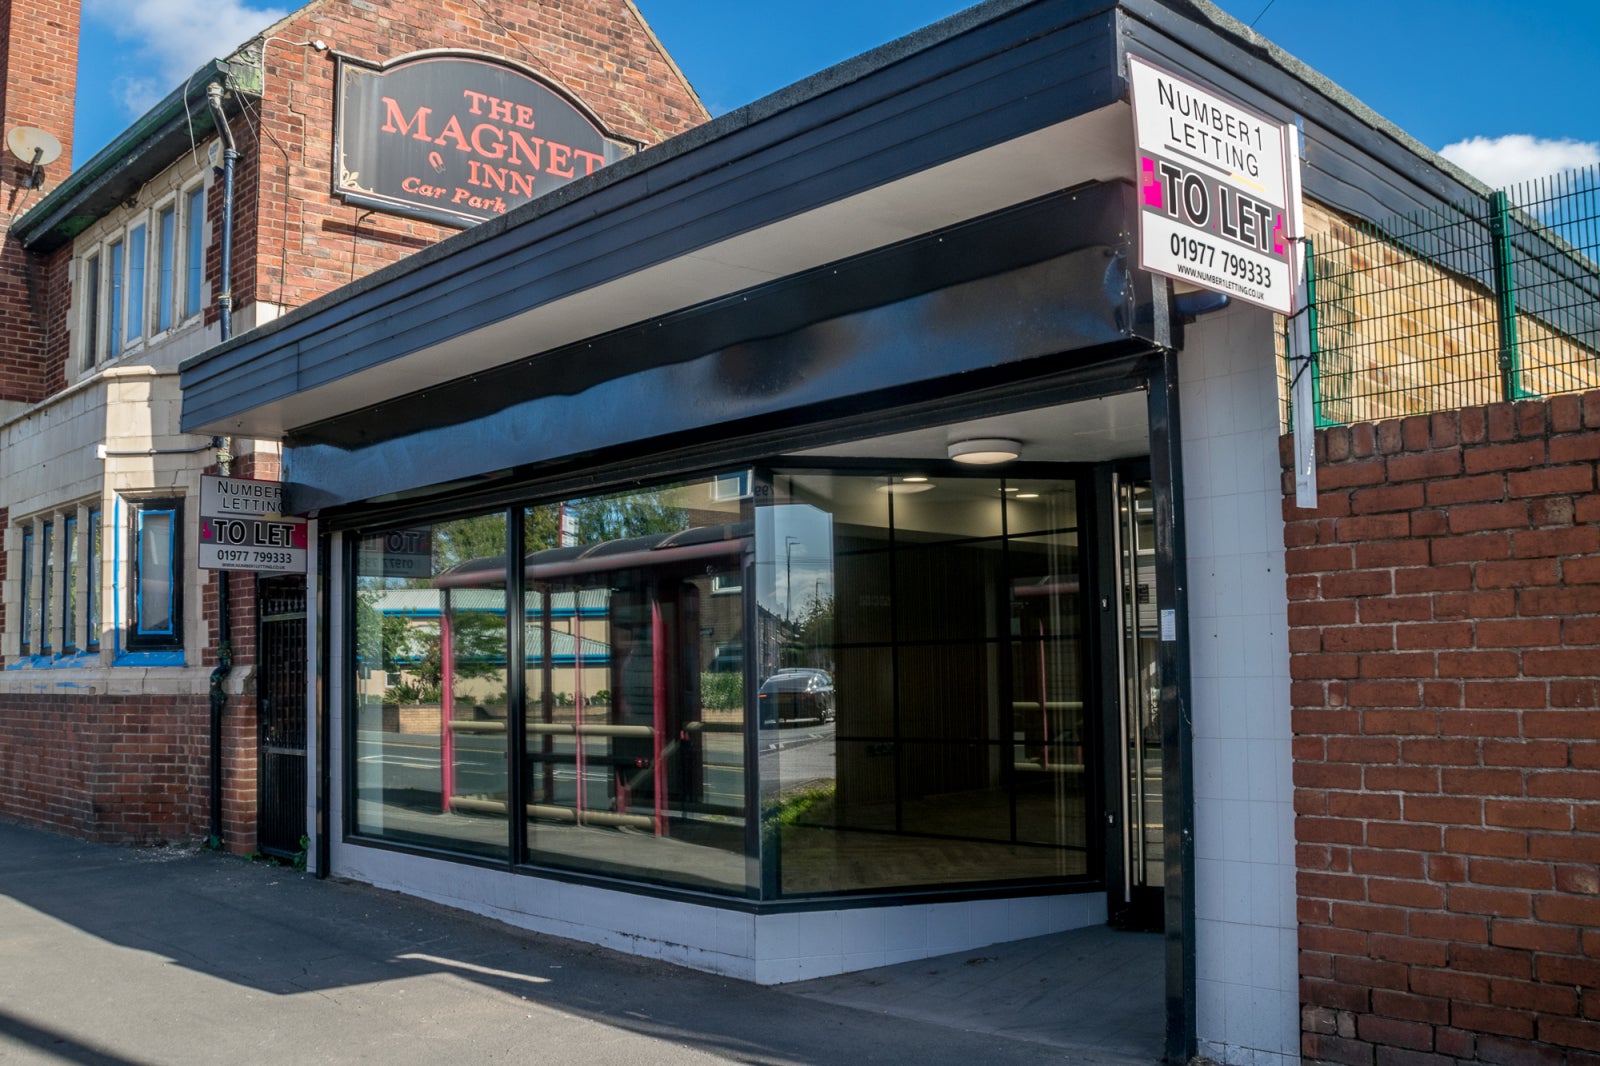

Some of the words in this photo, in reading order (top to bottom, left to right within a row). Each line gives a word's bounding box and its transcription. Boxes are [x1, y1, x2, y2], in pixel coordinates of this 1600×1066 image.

[464, 90, 535, 130] THE
[381, 97, 605, 180] MAGNET
[1169, 116, 1259, 178] LETTING
[402, 176, 447, 200] Car
[451, 187, 507, 214] Park
[467, 160, 535, 199] INN
[1160, 160, 1209, 227] TO
[1218, 185, 1273, 253] LET
[1170, 233, 1215, 268] 01977
[1221, 250, 1271, 288] 799333
[213, 519, 247, 545] TO
[253, 521, 296, 547] LET
[217, 549, 249, 562] 01977
[253, 551, 292, 564] 799333
